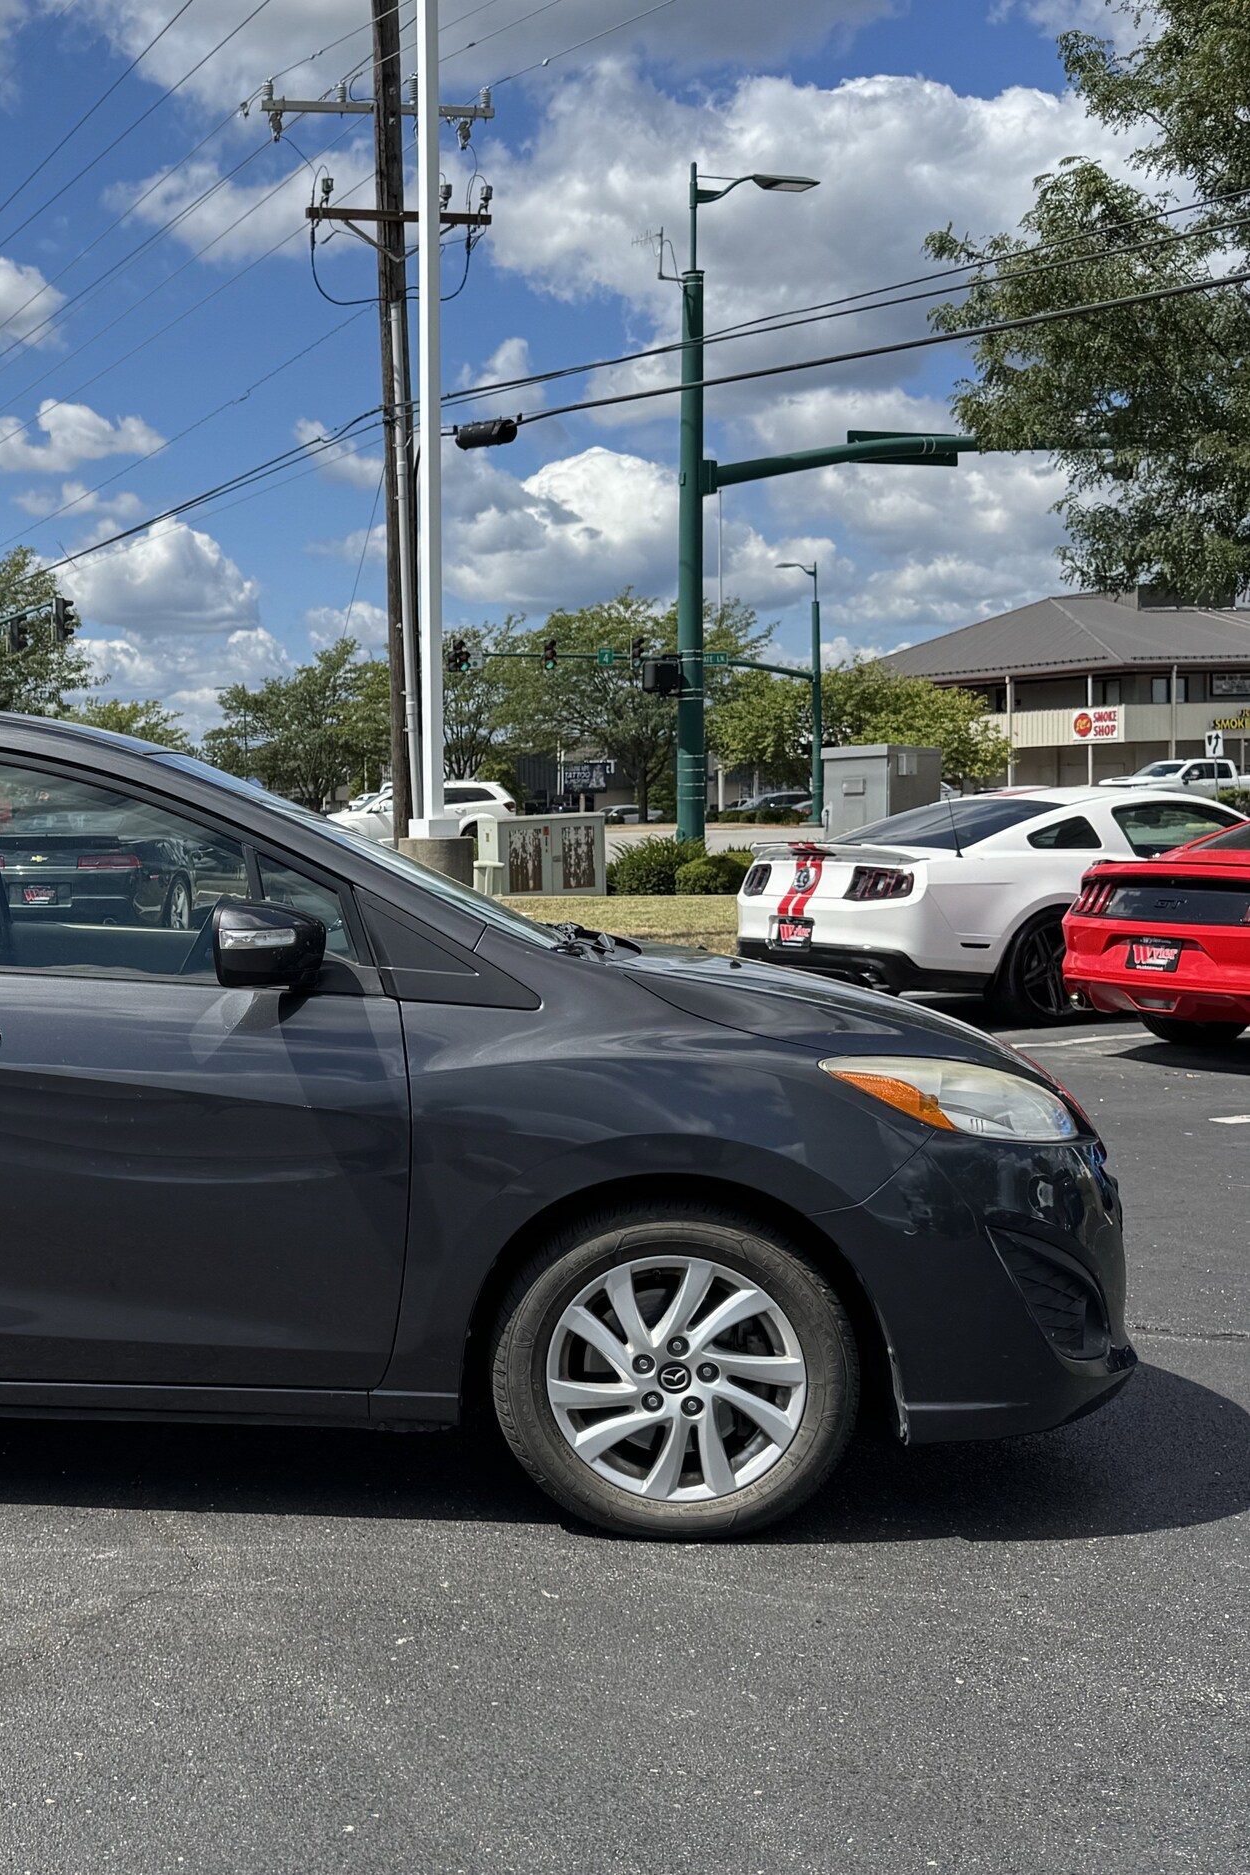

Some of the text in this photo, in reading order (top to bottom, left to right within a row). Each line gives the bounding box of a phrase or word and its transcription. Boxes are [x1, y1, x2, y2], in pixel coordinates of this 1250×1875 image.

[1093, 710, 1117, 723] SMOKE
[1093, 724, 1116, 737] SHOP
[564, 771, 591, 780] TATTOO
[1154, 899, 1187, 909] GT
[1133, 944, 1178, 965] Wyler
